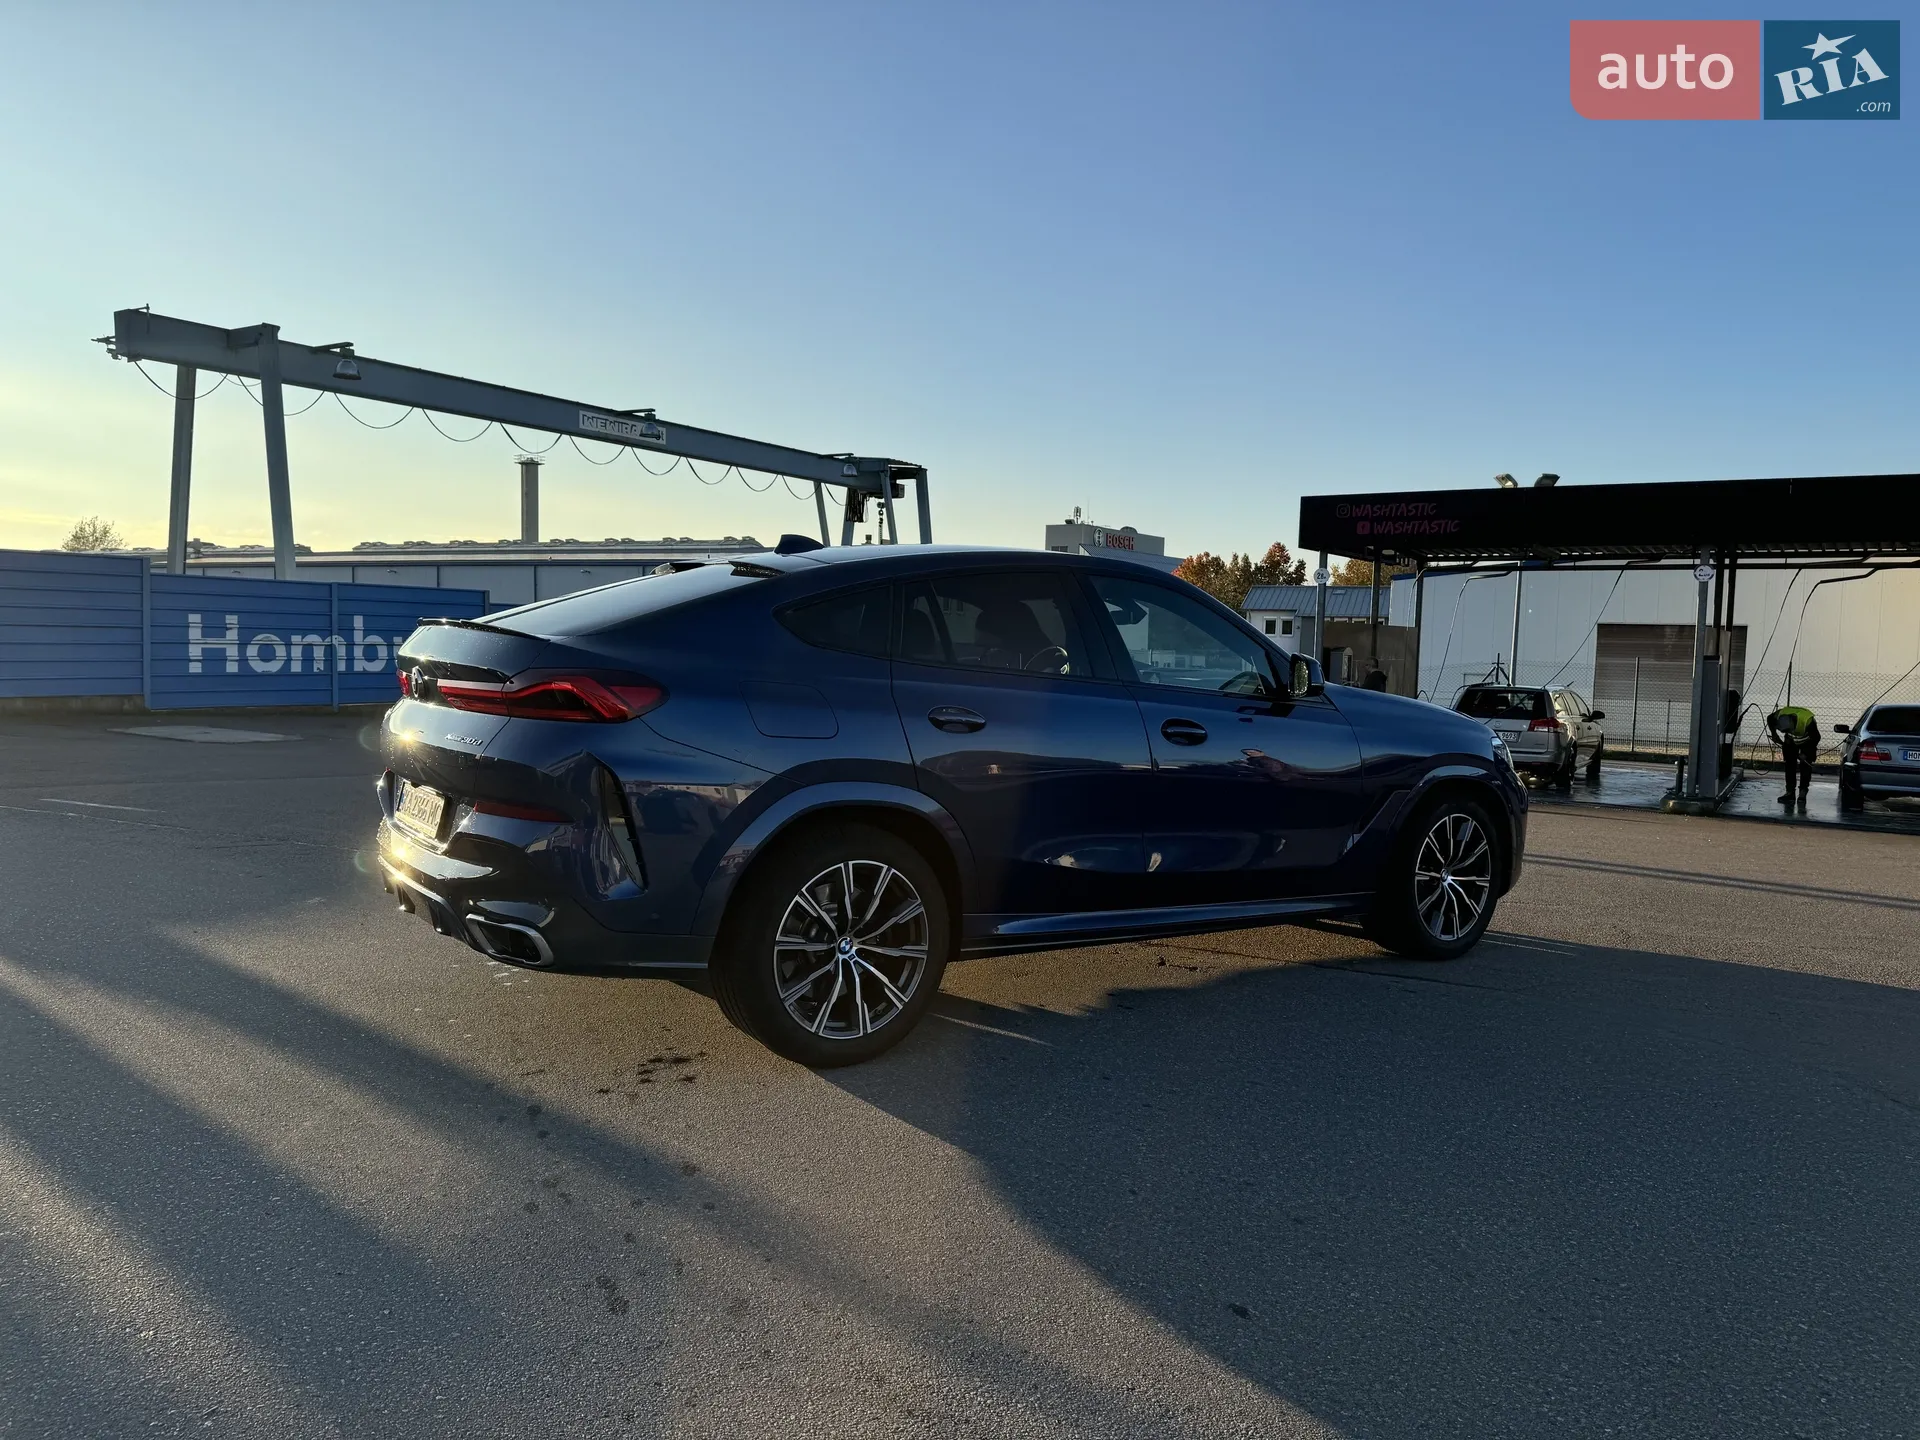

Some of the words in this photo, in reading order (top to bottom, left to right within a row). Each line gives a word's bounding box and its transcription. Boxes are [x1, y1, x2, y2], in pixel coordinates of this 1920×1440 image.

[1352, 503, 1437, 518] WASHTASTIC
[1374, 519, 1460, 534] WASHTASTIC
[1106, 533, 1134, 550] BOSCH
